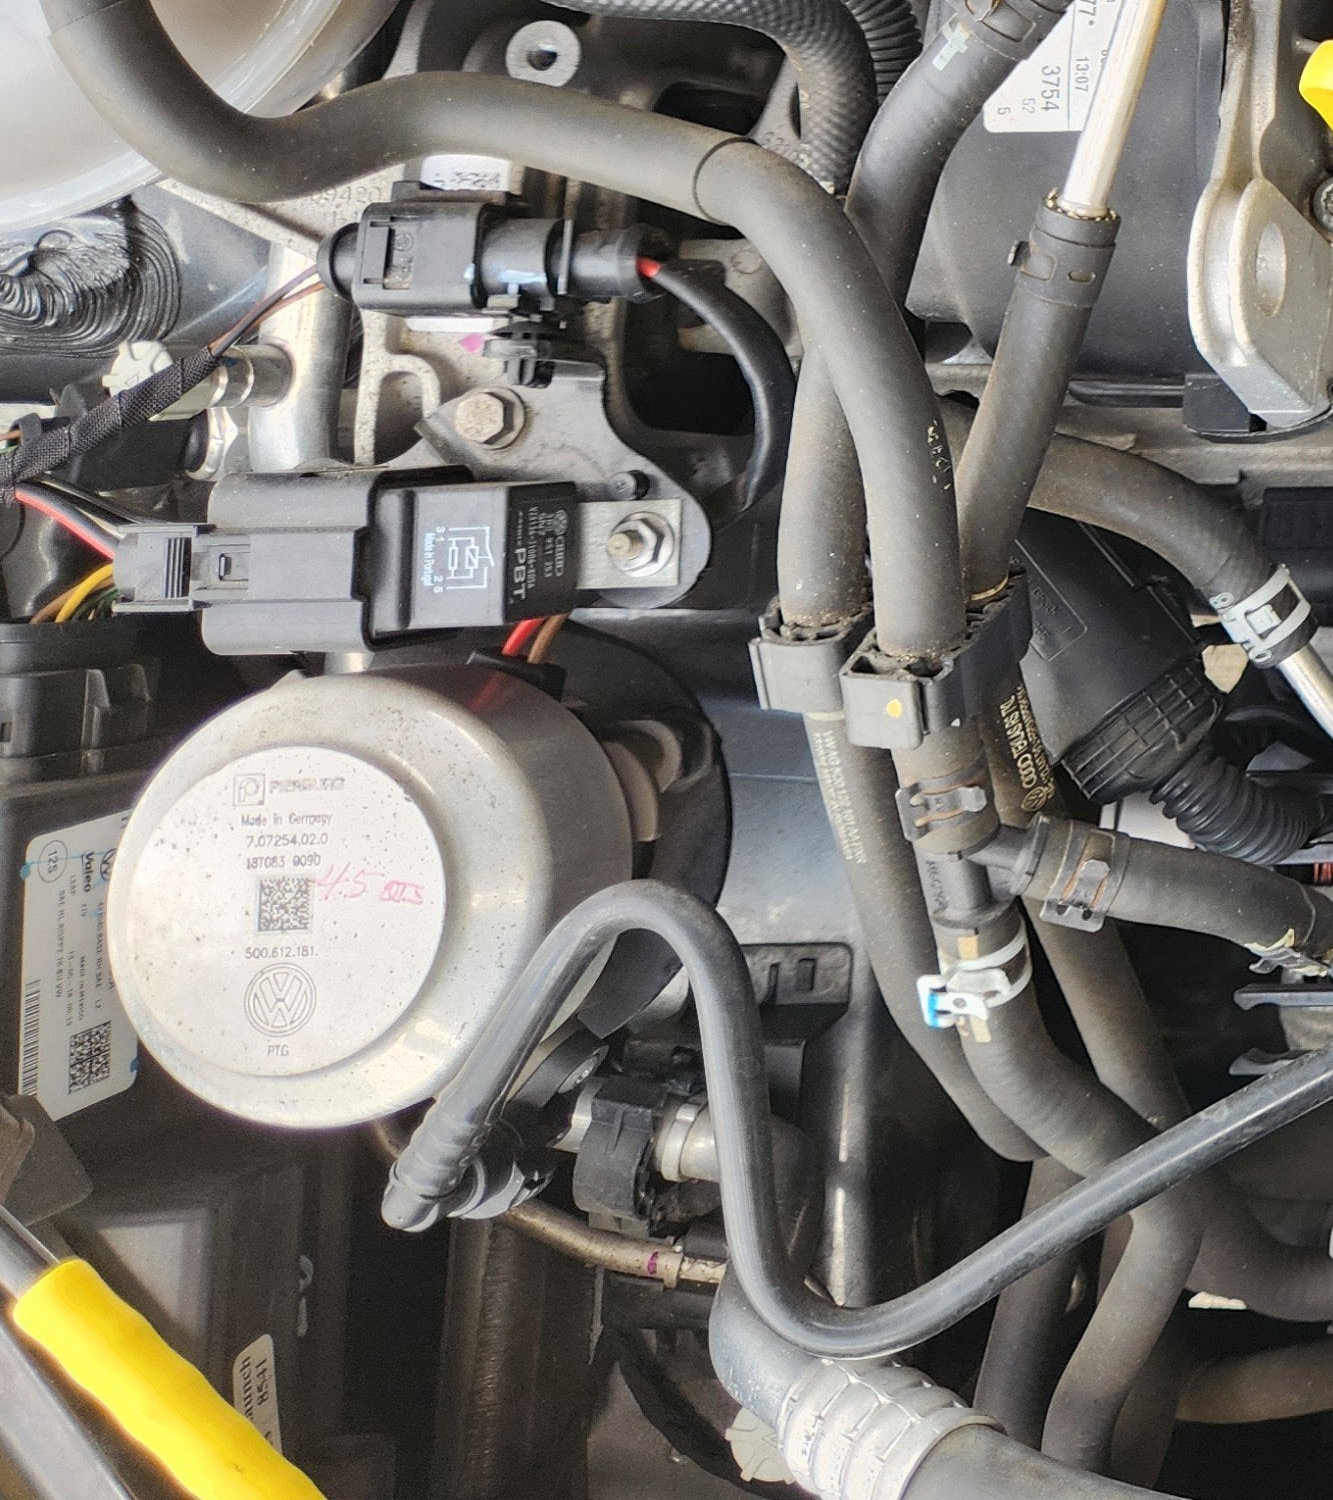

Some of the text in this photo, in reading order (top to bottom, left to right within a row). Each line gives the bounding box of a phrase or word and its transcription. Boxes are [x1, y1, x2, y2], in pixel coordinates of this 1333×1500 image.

[1072, 56, 1091, 91] 13:07
[1037, 64, 1064, 113] 3754
[996, 106, 1010, 115] 5
[424, 532, 436, 550] Made
[420, 560, 434, 586] Portugal
[241, 813, 266, 826] Made
[246, 834, 328, 848] 7.07254.02.0
[83, 851, 95, 893] Valeo
[267, 1044, 288, 1056] PTG
[238, 1355, 255, 1420] aunch
